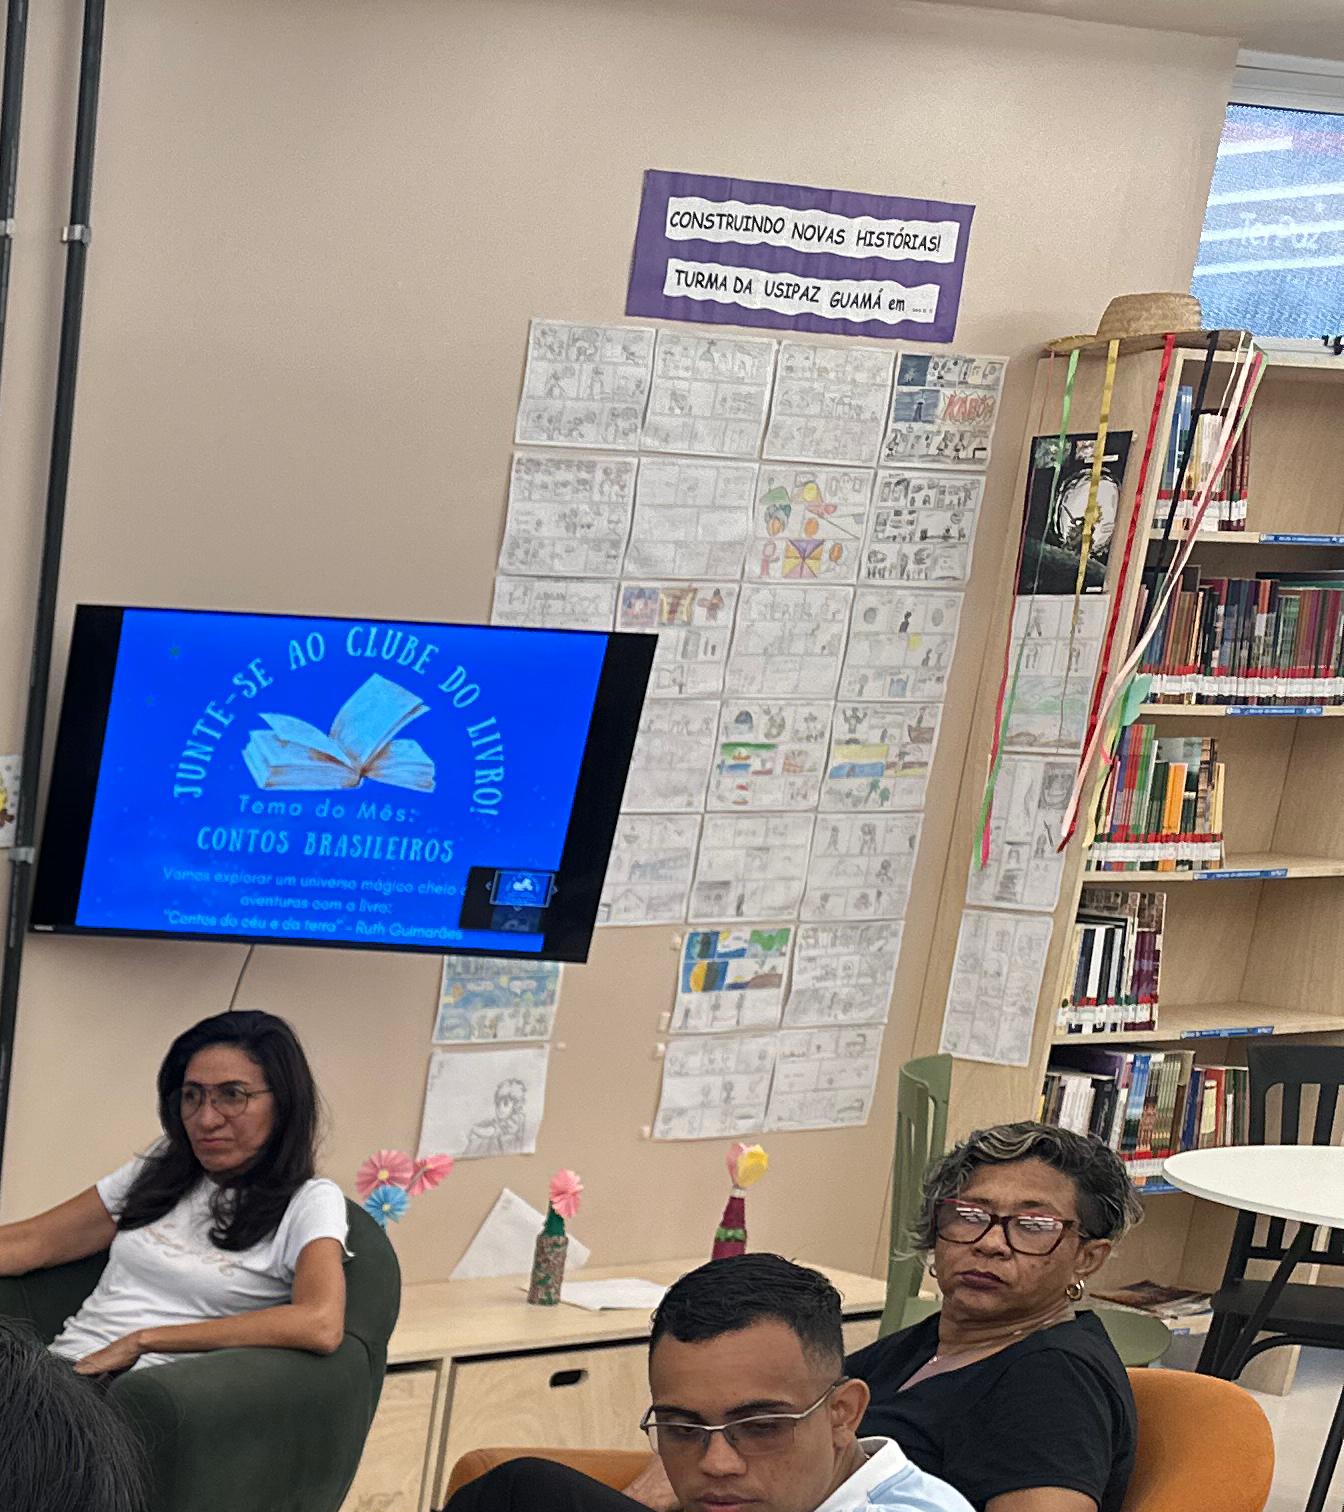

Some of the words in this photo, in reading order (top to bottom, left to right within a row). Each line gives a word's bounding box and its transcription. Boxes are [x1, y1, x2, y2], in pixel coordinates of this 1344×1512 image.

[670, 211, 785, 234] CONSTRUINDO
[792, 222, 845, 245] NOVAS
[856, 227, 941, 252] HISTÓRIAS!
[675, 269, 728, 291] TURMA
[733, 276, 752, 295] DA
[765, 281, 821, 303] USIPAZ
[830, 288, 881, 309] GUAMÁ
[888, 298, 905, 311] em
[173, 657, 274, 798] JUNTE-SE
[288, 631, 326, 671] AO
[346, 626, 439, 675] CLUBE
[438, 665, 481, 709] DO
[466, 716, 506, 816] LIVRO!
[238, 794, 303, 817] Tema
[315, 798, 346, 819] do
[357, 801, 416, 823] Mês:
[197, 826, 290, 853] CONTOS
[304, 831, 455, 864] BRASILEIROS
[163, 867, 211, 882] Vamos
[214, 871, 273, 888] explorar
[275, 876, 297, 887] um
[300, 876, 357, 891] universo
[361, 878, 414, 896] mágico
[418, 879, 457, 896] cheio
[239, 895, 309, 910] aventuras
[311, 899, 342, 911] com
[269, 919, 280, 930] e
[281, 916, 301, 931] da
[355, 919, 386, 937] Ruth
[389, 922, 464, 941] Guimarães
